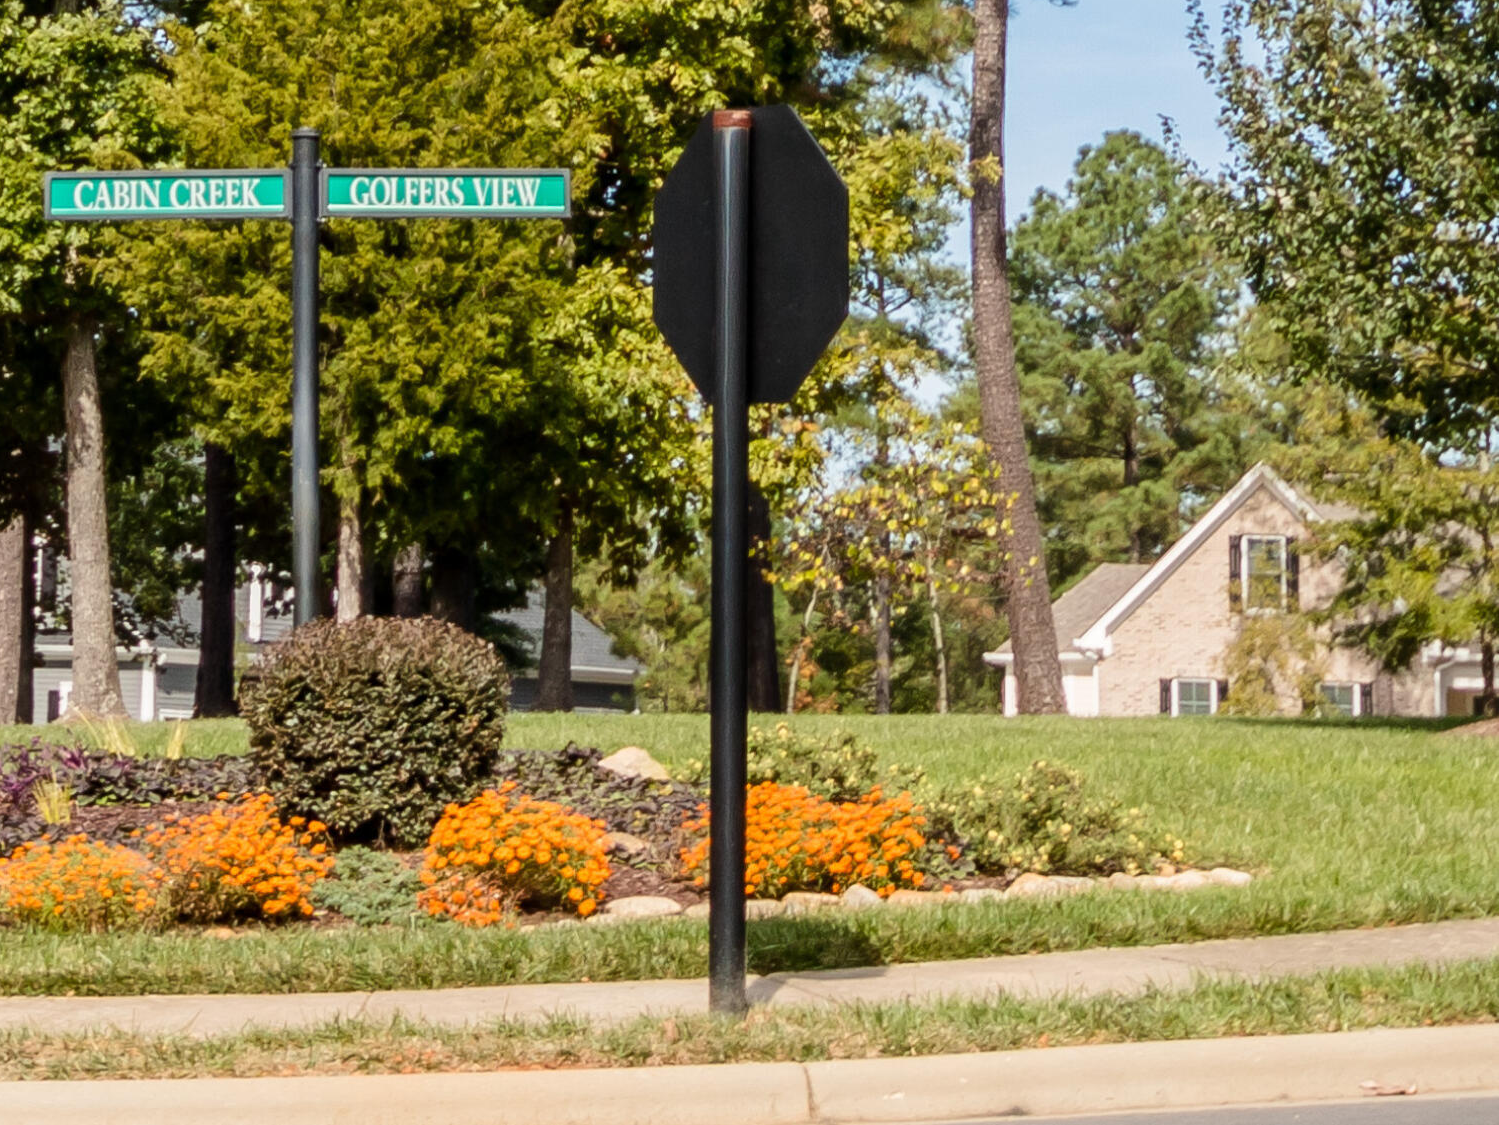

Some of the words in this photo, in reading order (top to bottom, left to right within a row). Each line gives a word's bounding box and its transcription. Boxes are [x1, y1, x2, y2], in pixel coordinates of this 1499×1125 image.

[73, 179, 160, 210] CABIN
[169, 178, 261, 209] CREEK
[349, 176, 465, 207] GOLFERS
[474, 176, 541, 207] VIEW
